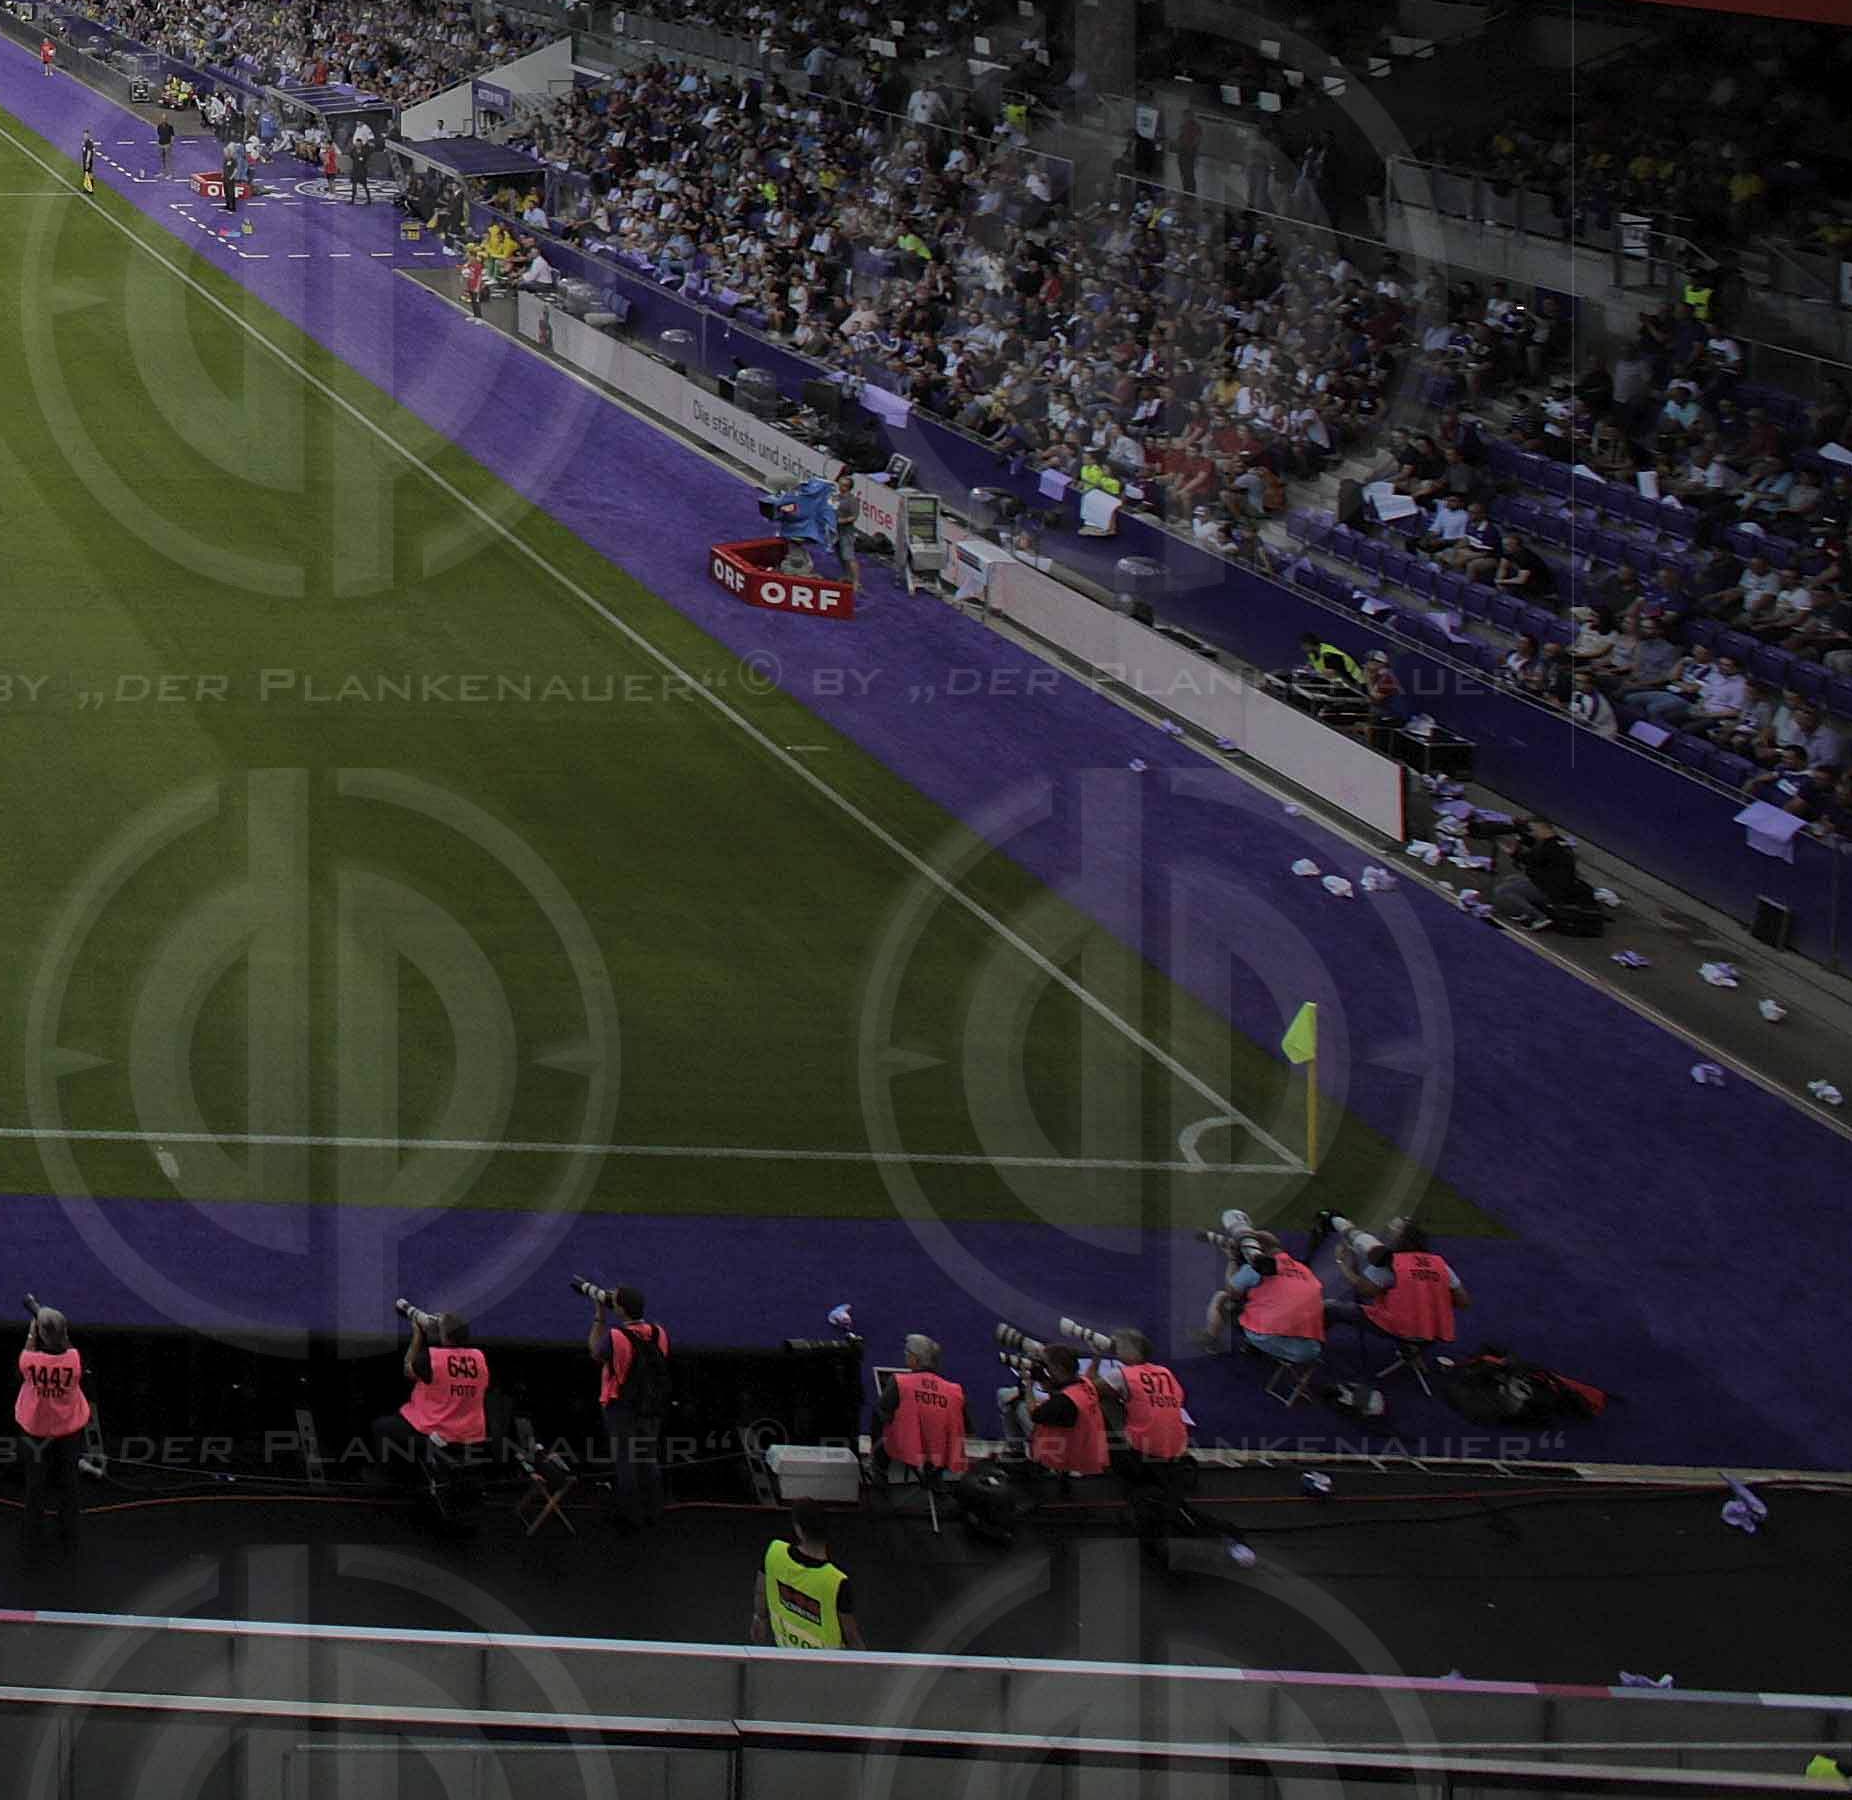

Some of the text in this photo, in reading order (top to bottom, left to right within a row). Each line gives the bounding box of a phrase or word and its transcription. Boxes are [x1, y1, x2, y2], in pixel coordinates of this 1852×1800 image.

[691, 398, 780, 466] Die stärkste und
[712, 555, 746, 594] ORF
[759, 580, 842, 612] ORF
[27, 1364, 73, 1388] 1447
[447, 1354, 478, 1379] 643
[914, 1390, 948, 1409] FOTO
